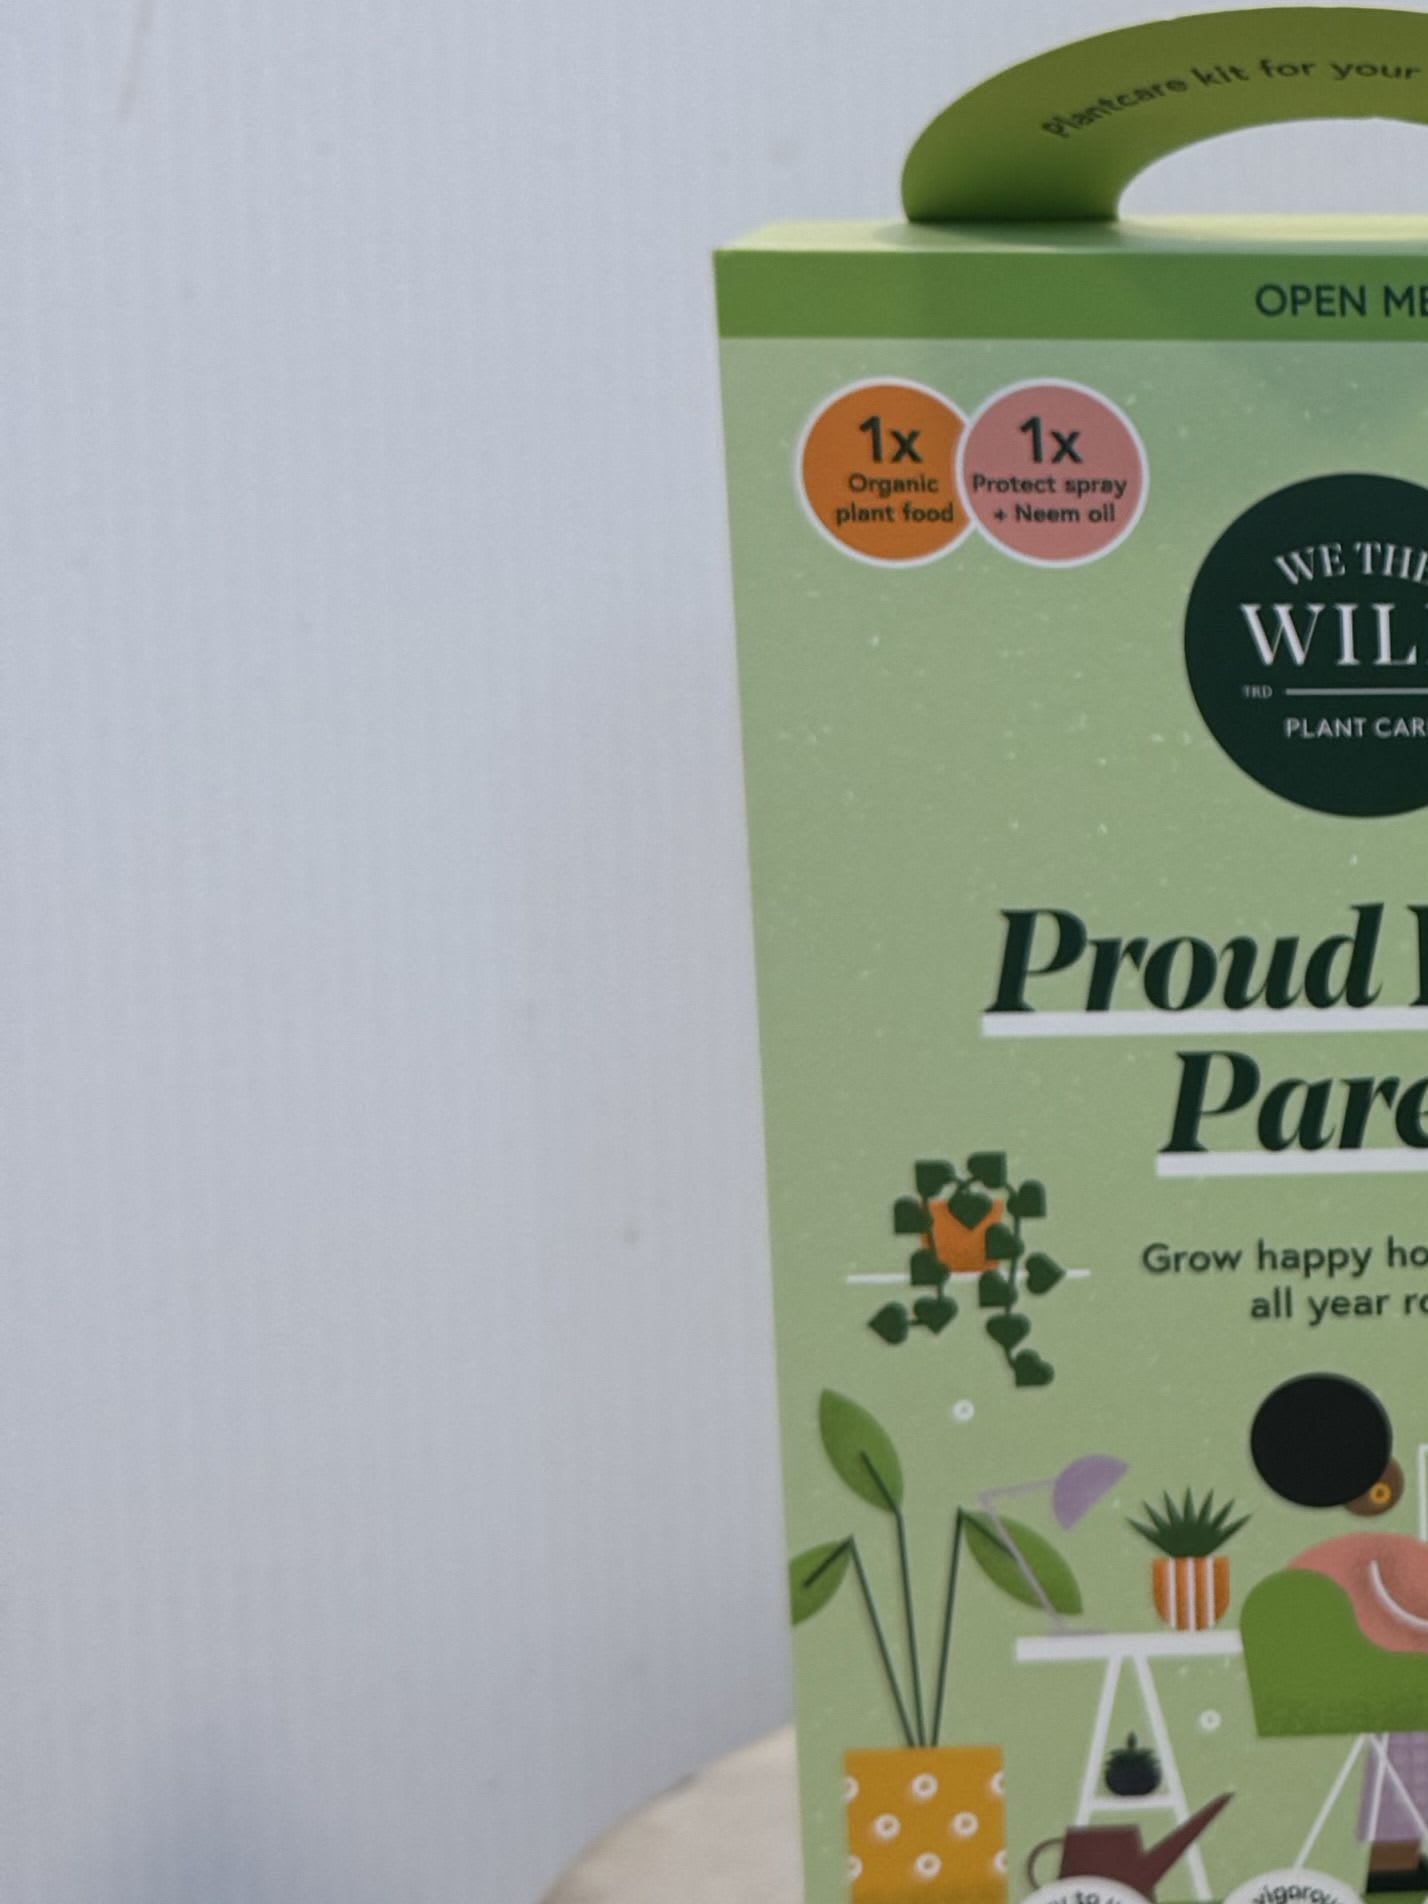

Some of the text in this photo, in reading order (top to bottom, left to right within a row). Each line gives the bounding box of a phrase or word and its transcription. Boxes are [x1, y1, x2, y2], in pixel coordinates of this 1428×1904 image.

[1042, 77, 1188, 138] Plantcare
[1191, 64, 1249, 86] kit
[1260, 59, 1316, 77] for
[1330, 63, 1421, 80] your
[1256, 283, 1366, 318] OPEN
[859, 415, 922, 464] 1x
[1019, 415, 1083, 464] 1x
[848, 474, 939, 497] Organic
[972, 475, 1127, 498] Protect spray
[835, 504, 954, 526] plant food
[1015, 505, 1080, 524] Neem
[1088, 505, 1115, 524] oil
[1274, 542, 1345, 585] WE
[1242, 685, 1272, 698] TRD
[1284, 718, 1367, 738] PLANT
[985, 902, 1385, 1012] Proud
[1142, 1243, 1242, 1274] Grow
[1257, 1241, 1373, 1278] happy
[1251, 1288, 1293, 1320] all
[1309, 1291, 1390, 1325] year
